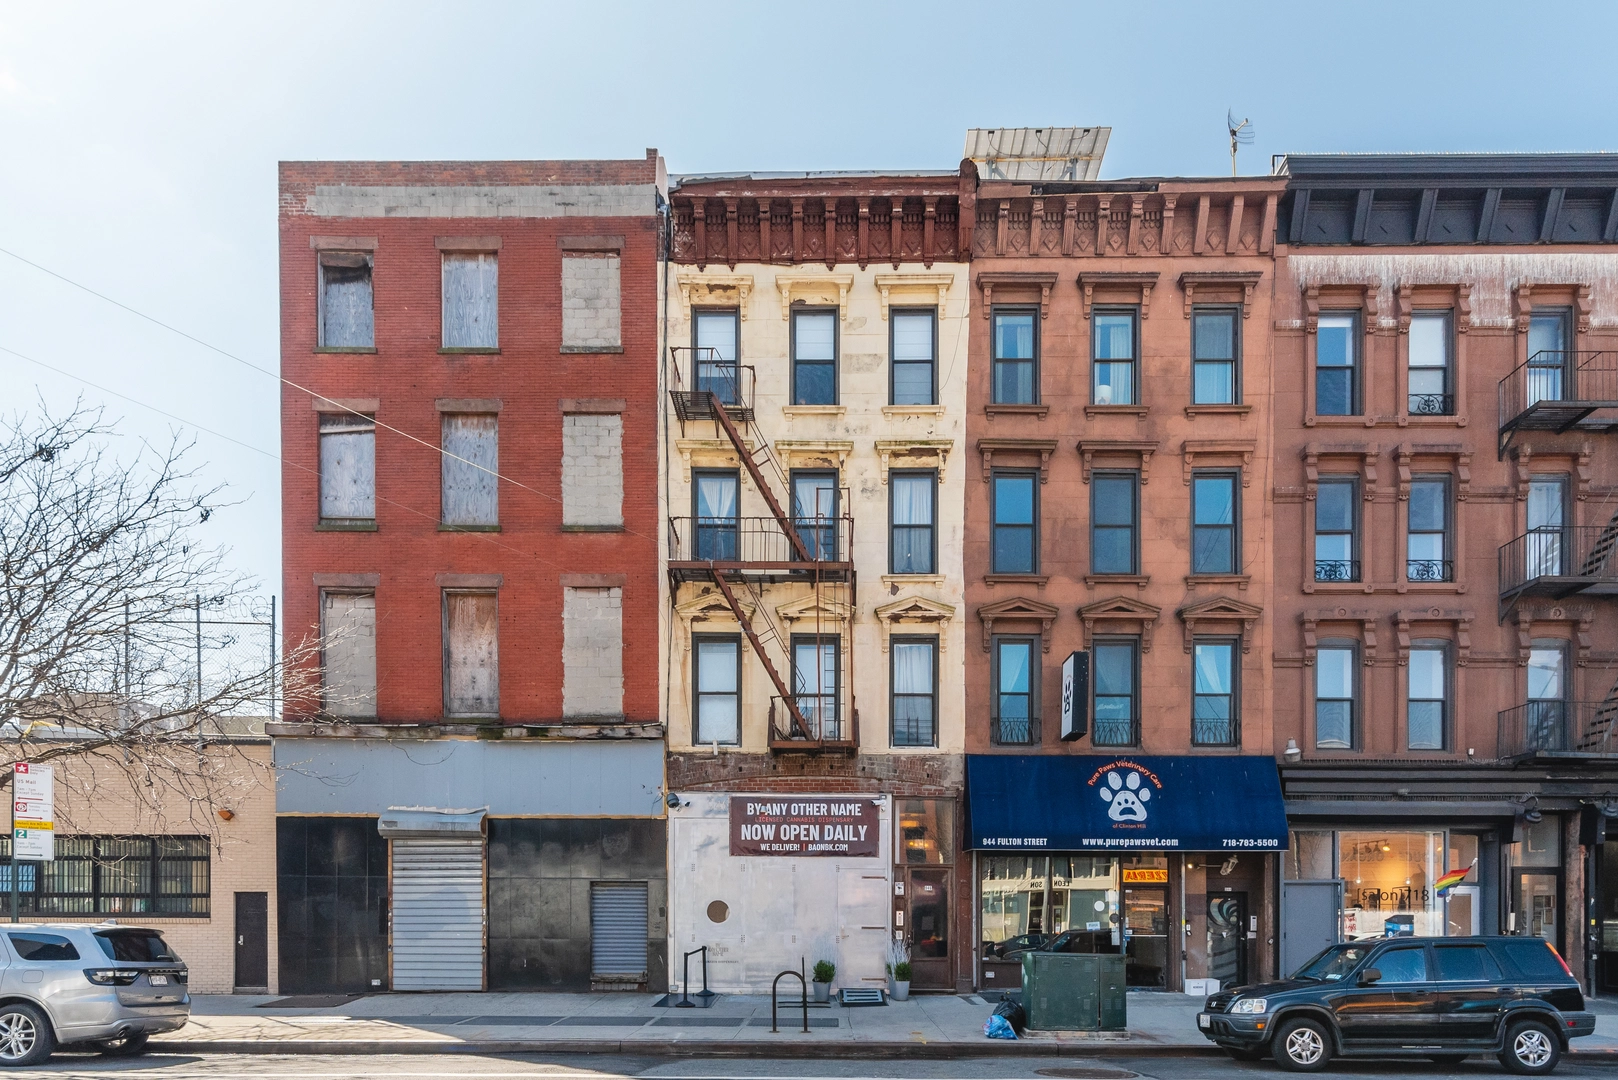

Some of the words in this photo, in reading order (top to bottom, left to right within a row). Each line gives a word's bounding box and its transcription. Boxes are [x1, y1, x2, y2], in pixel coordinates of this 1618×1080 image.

[1087, 772, 1100, 786] Pure
[1098, 762, 1116, 774] Paws
[1115, 760, 1151, 776] Veterinary
[1150, 774, 1162, 789] Care
[747, 803, 761, 815] BY
[765, 803, 788, 815] ANY
[790, 803, 828, 816] OTHER
[830, 804, 862, 816] NAME
[18, 830, 25, 838] 2
[741, 824, 776, 841] NOW
[780, 824, 820, 841] OPEN
[824, 824, 868, 841] DAILY
[982, 838, 996, 846] 944
[997, 838, 1022, 846] FULTON
[1023, 838, 1048, 846] STREET
[1082, 837, 1179, 848] www.purepawsvet.com
[1222, 839, 1278, 847] 718-783-5500
[760, 843, 771, 851] WE
[771, 843, 800, 851] DELIVER!
[808, 843, 849, 851] BAONBK.COM
